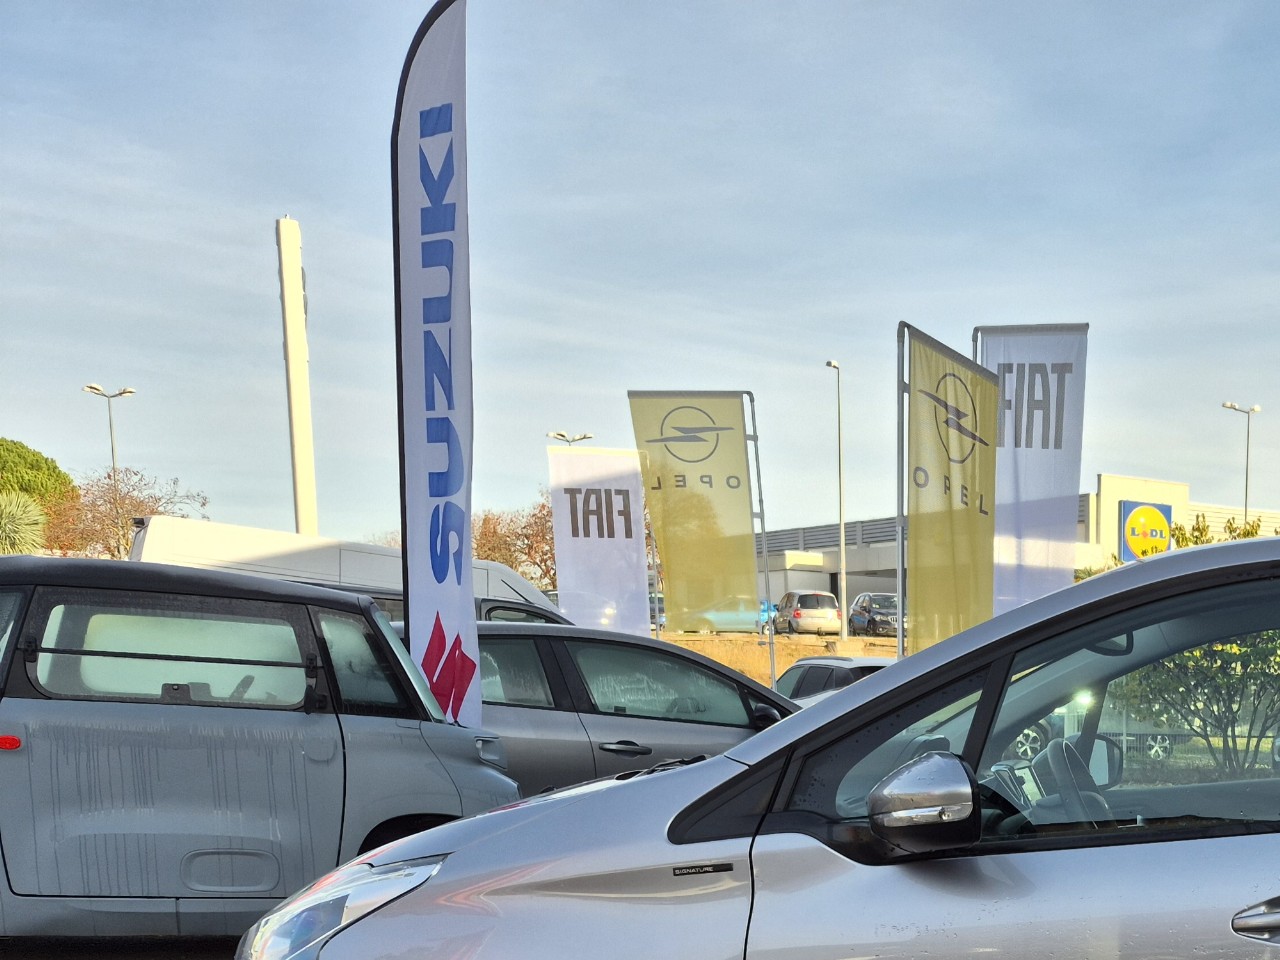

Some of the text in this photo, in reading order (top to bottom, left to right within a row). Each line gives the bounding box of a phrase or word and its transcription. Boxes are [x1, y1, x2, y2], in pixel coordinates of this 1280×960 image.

[418, 102, 465, 587] SUZUKI
[996, 363, 1073, 450] FIAT
[912, 466, 989, 516] OPEL
[674, 866, 714, 875] SIGNATURE
